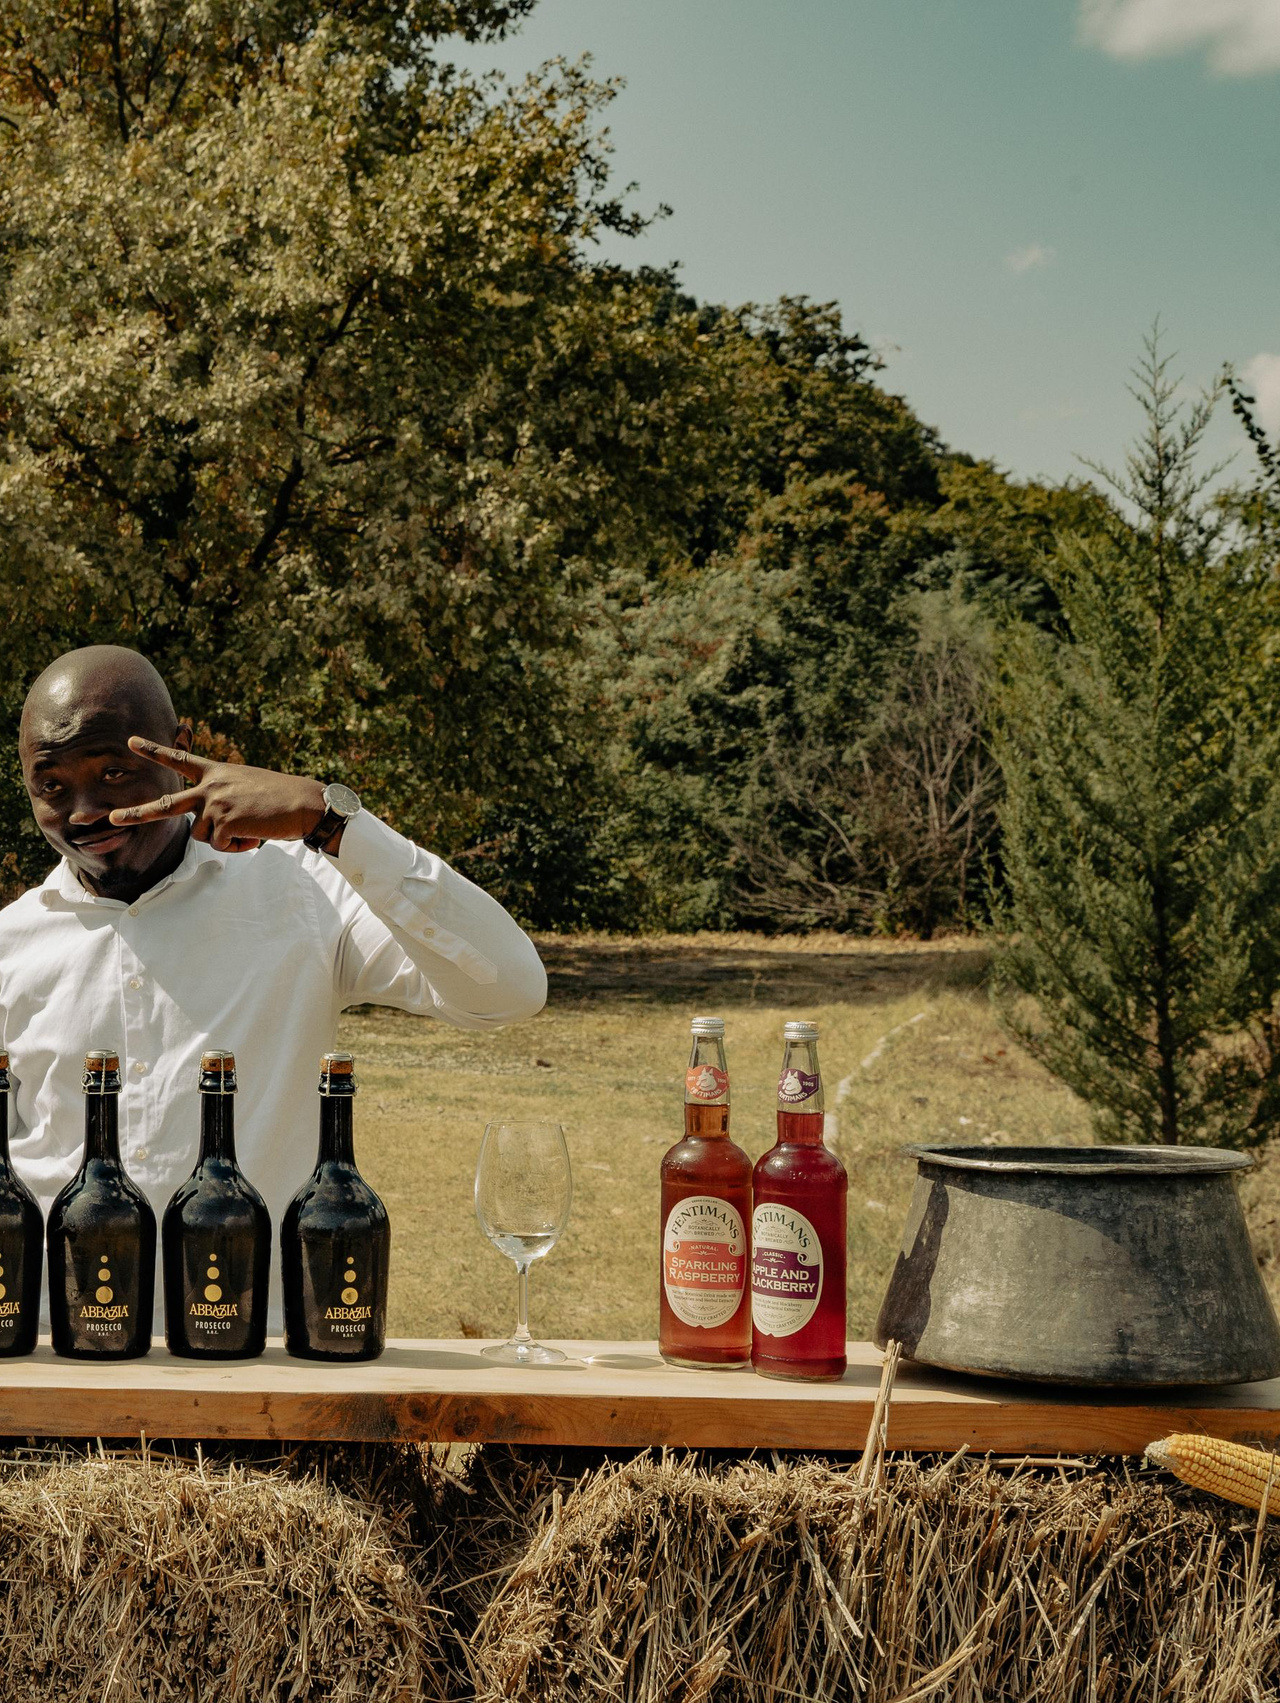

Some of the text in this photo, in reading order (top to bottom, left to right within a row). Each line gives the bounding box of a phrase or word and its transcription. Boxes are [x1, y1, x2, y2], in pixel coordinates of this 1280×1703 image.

[671, 1205, 740, 1239] FENTIMANS
[671, 1256, 737, 1271] SPARKLING
[669, 1267, 740, 1282] RASPBERRY
[780, 1269, 810, 1280] AND
[79, 1305, 129, 1321] ABBAZIA
[189, 1303, 239, 1319] ABBAZIA
[324, 1306, 372, 1322] ABBAZIA
[707, 1309, 727, 1321] CRAFTED
[86, 1322, 122, 1331] PROSECCO
[195, 1320, 231, 1330] PROSECCO
[330, 1324, 366, 1333] PROSECCO
[776, 1318, 796, 1328] CRAFTED
